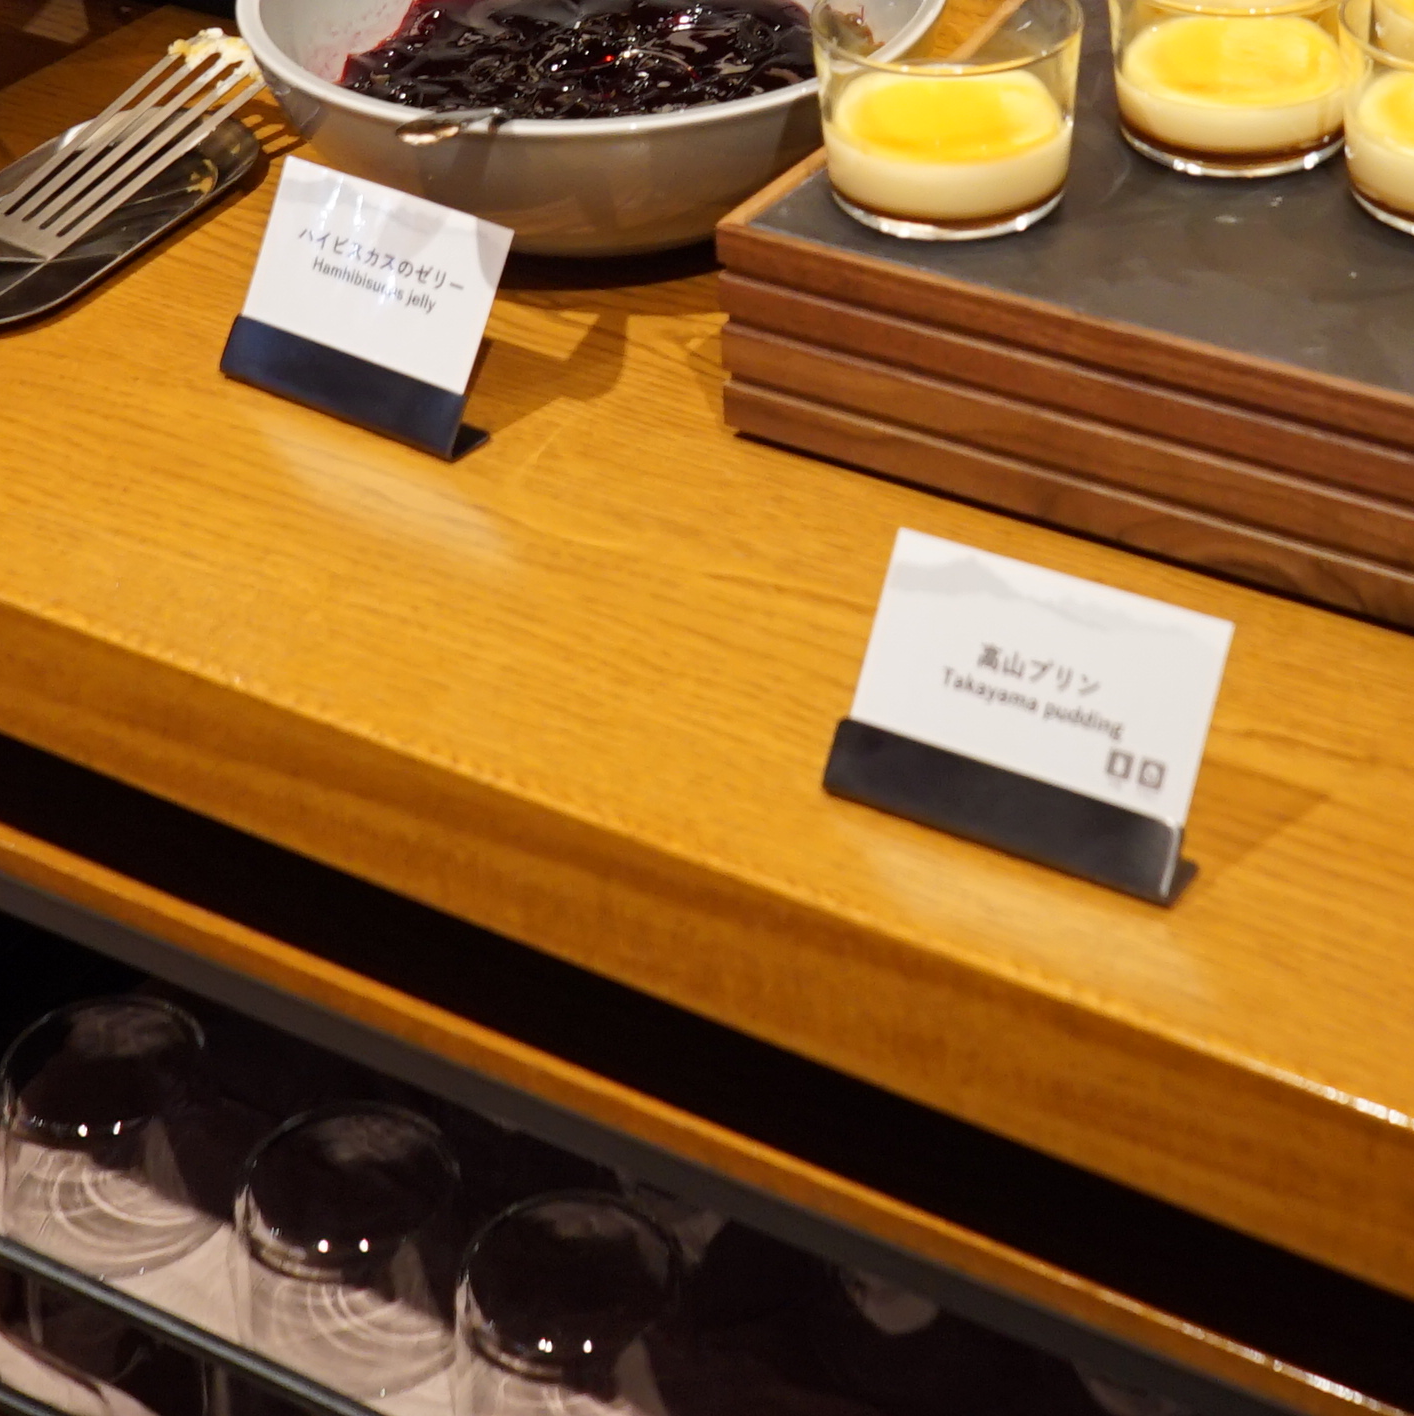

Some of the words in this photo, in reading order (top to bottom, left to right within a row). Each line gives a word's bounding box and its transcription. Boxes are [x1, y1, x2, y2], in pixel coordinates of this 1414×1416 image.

[405, 289, 436, 315] jelly
[976, 642, 1101, 698] 高山プリン
[942, 665, 1039, 714] Takayama
[1042, 701, 1125, 741] pudding
